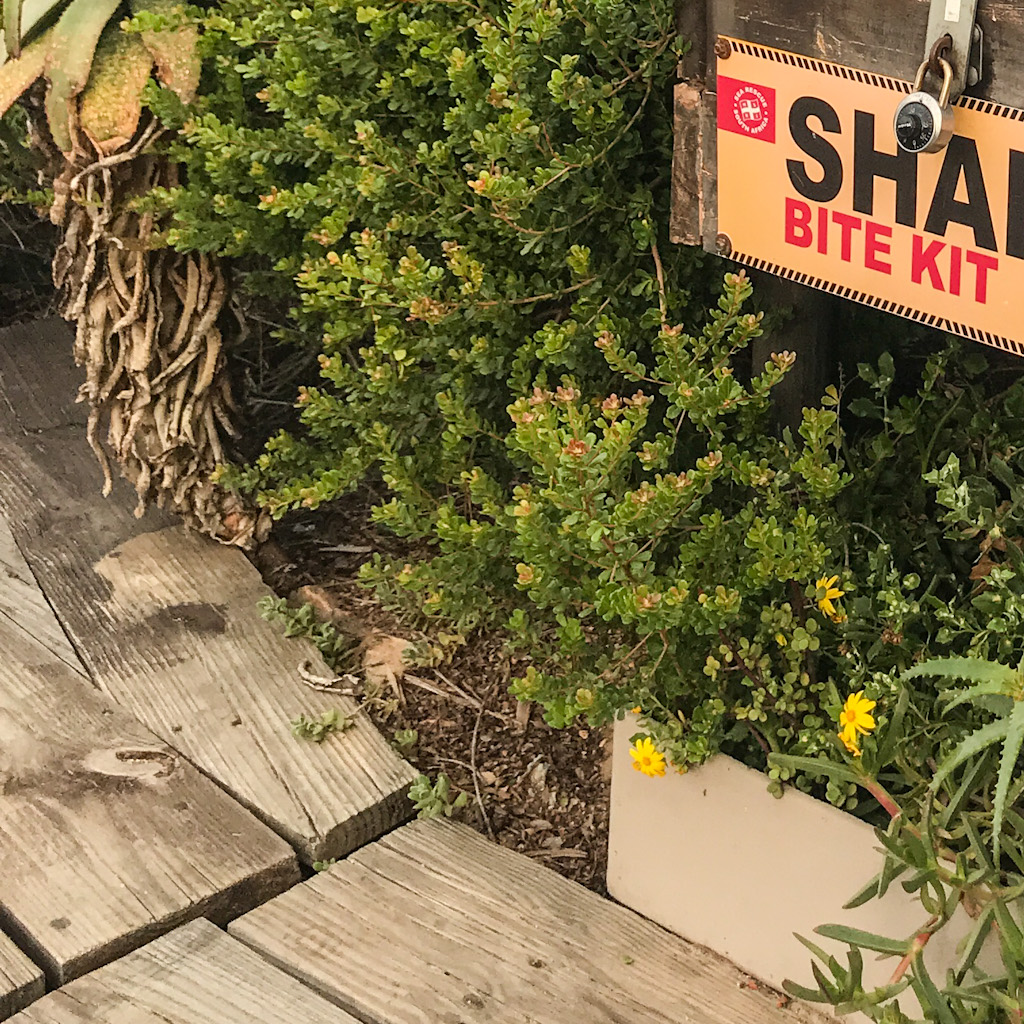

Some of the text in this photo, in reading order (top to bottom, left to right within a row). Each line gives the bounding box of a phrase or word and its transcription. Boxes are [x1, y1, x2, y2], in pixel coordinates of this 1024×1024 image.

[733, 86, 768, 108] SEA RESCUE
[732, 109, 769, 134] SOUTH AFRICA
[785, 197, 999, 304] BITE KIT
